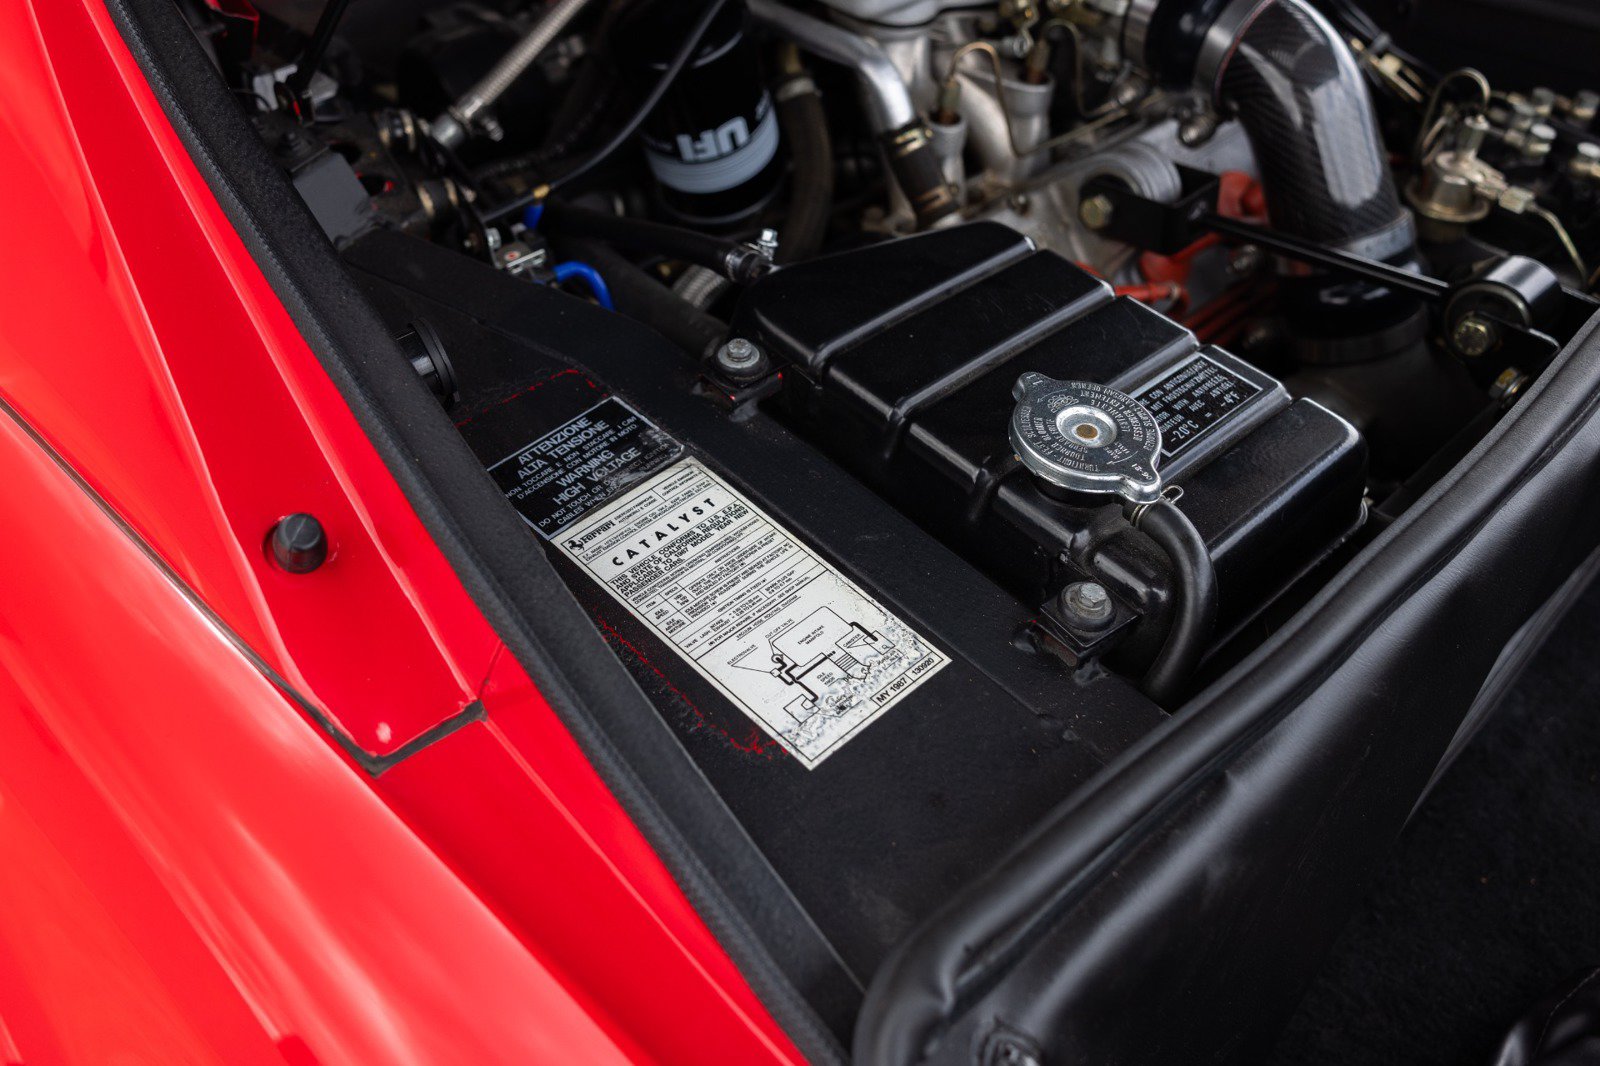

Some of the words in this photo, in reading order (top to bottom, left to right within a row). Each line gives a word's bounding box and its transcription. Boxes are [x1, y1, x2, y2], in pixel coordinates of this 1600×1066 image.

[676, 116, 750, 162] UFI
[515, 417, 593, 466] ATTENZIONE
[515, 457, 548, 479] ALTA
[546, 420, 610, 460] TENSIONE
[521, 466, 555, 488] TOCCARE
[563, 450, 581, 462] NON
[582, 429, 616, 451] STACCARE
[517, 467, 567, 500] D'ACCENSIONE
[565, 457, 583, 470] CON
[582, 441, 610, 459] MOTORE
[553, 482, 587, 506] HIGH
[586, 446, 642, 484] VOLTAGE
[555, 449, 615, 488] WARNING
[551, 508, 568, 520] NOT
[566, 492, 592, 510] TOUCH
[556, 505, 585, 526] CABLES
[579, 519, 617, 544] Ferrari
[610, 498, 717, 568] CATALYST
[610, 573, 629, 586] THIS
[628, 554, 658, 574] VEHICLE
[657, 530, 697, 556] CONFORMS
[707, 514, 723, 524] U.S.
[722, 502, 741, 515] E.P.A.
[614, 577, 632, 590] AND
[630, 563, 654, 579] STATE
[663, 533, 703, 559] CALIFORNIA
[701, 505, 746, 534] REGULATIONS
[619, 565, 662, 594] APPLICABLE
[674, 547, 691, 559] 1987
[690, 531, 715, 548] MODEL
[715, 519, 734, 532] YEAR
[733, 509, 750, 521] NEW
[623, 569, 665, 597] PASSENGER
[663, 556, 686, 572] CARS.
[664, 586, 679, 596] SPECS
[889, 677, 909, 693] 1987
